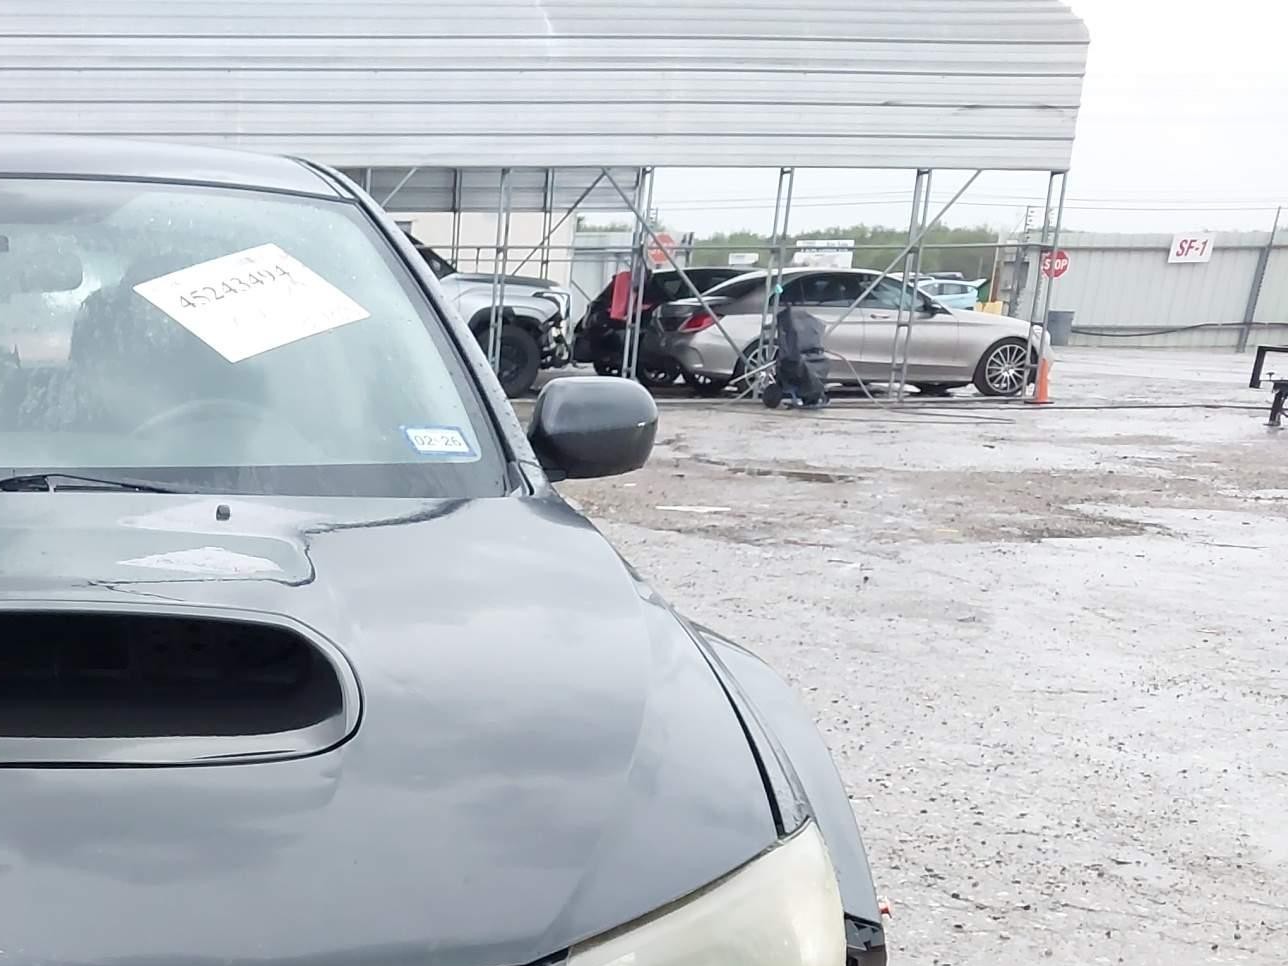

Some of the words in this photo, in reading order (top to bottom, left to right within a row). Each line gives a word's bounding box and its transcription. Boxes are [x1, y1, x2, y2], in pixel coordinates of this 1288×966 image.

[1175, 239, 1209, 257] SF-1
[1043, 258, 1068, 270] SOP
[178, 264, 291, 309] 45243494
